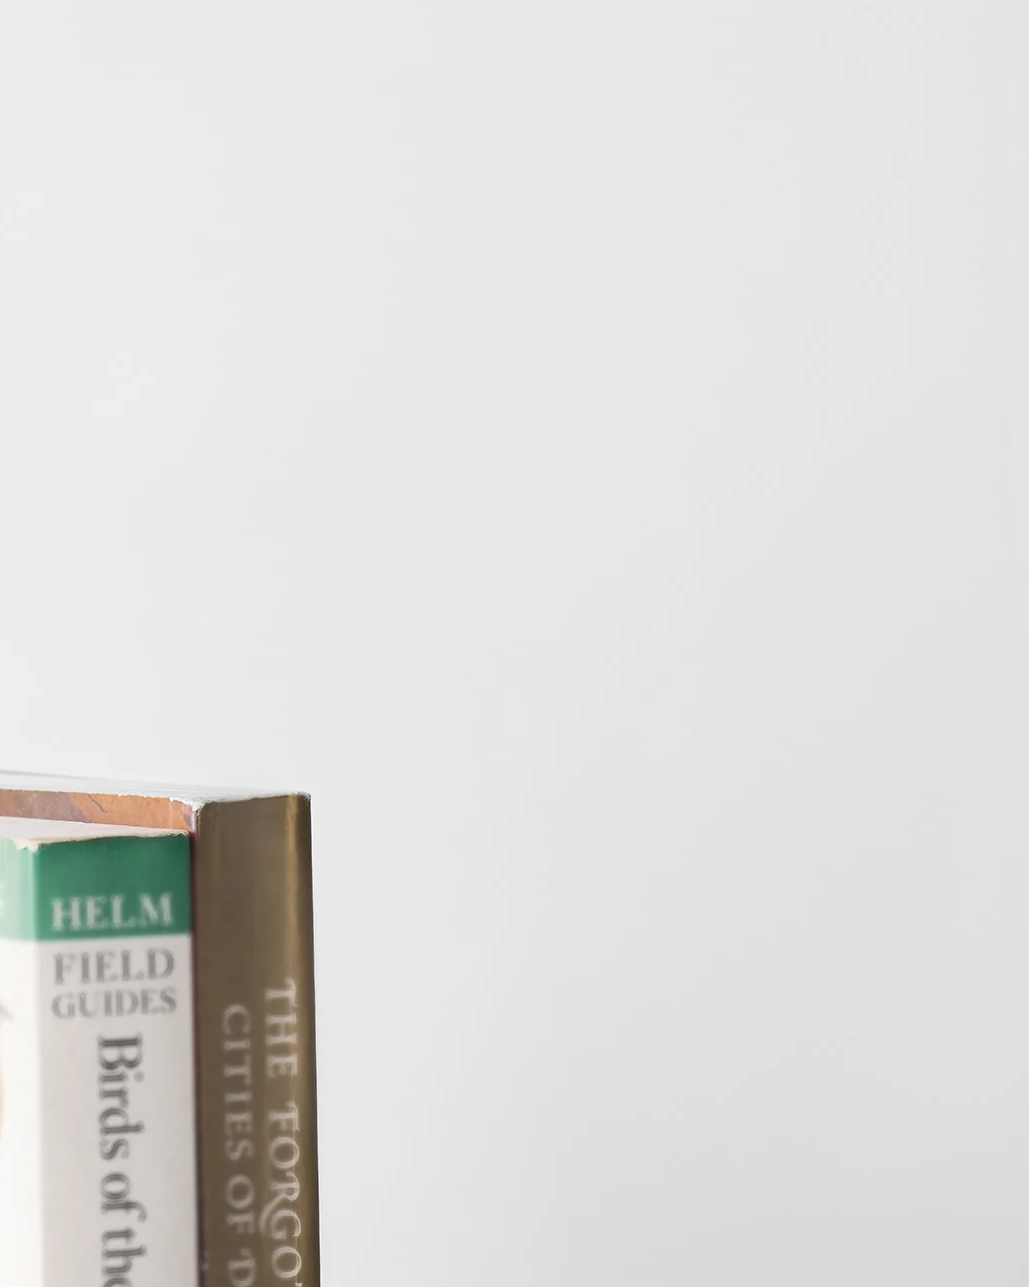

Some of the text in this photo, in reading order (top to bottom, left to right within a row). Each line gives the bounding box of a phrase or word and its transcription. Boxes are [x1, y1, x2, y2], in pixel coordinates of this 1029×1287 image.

[51, 893, 175, 932] HELM
[54, 950, 176, 984] FIELD
[51, 988, 178, 1019] GUIDES
[264, 977, 298, 1079] THE
[98, 1032, 145, 1162] Birds
[222, 1003, 253, 1162] CITIES
[100, 1172, 147, 1223] of
[226, 1175, 256, 1235] OF
